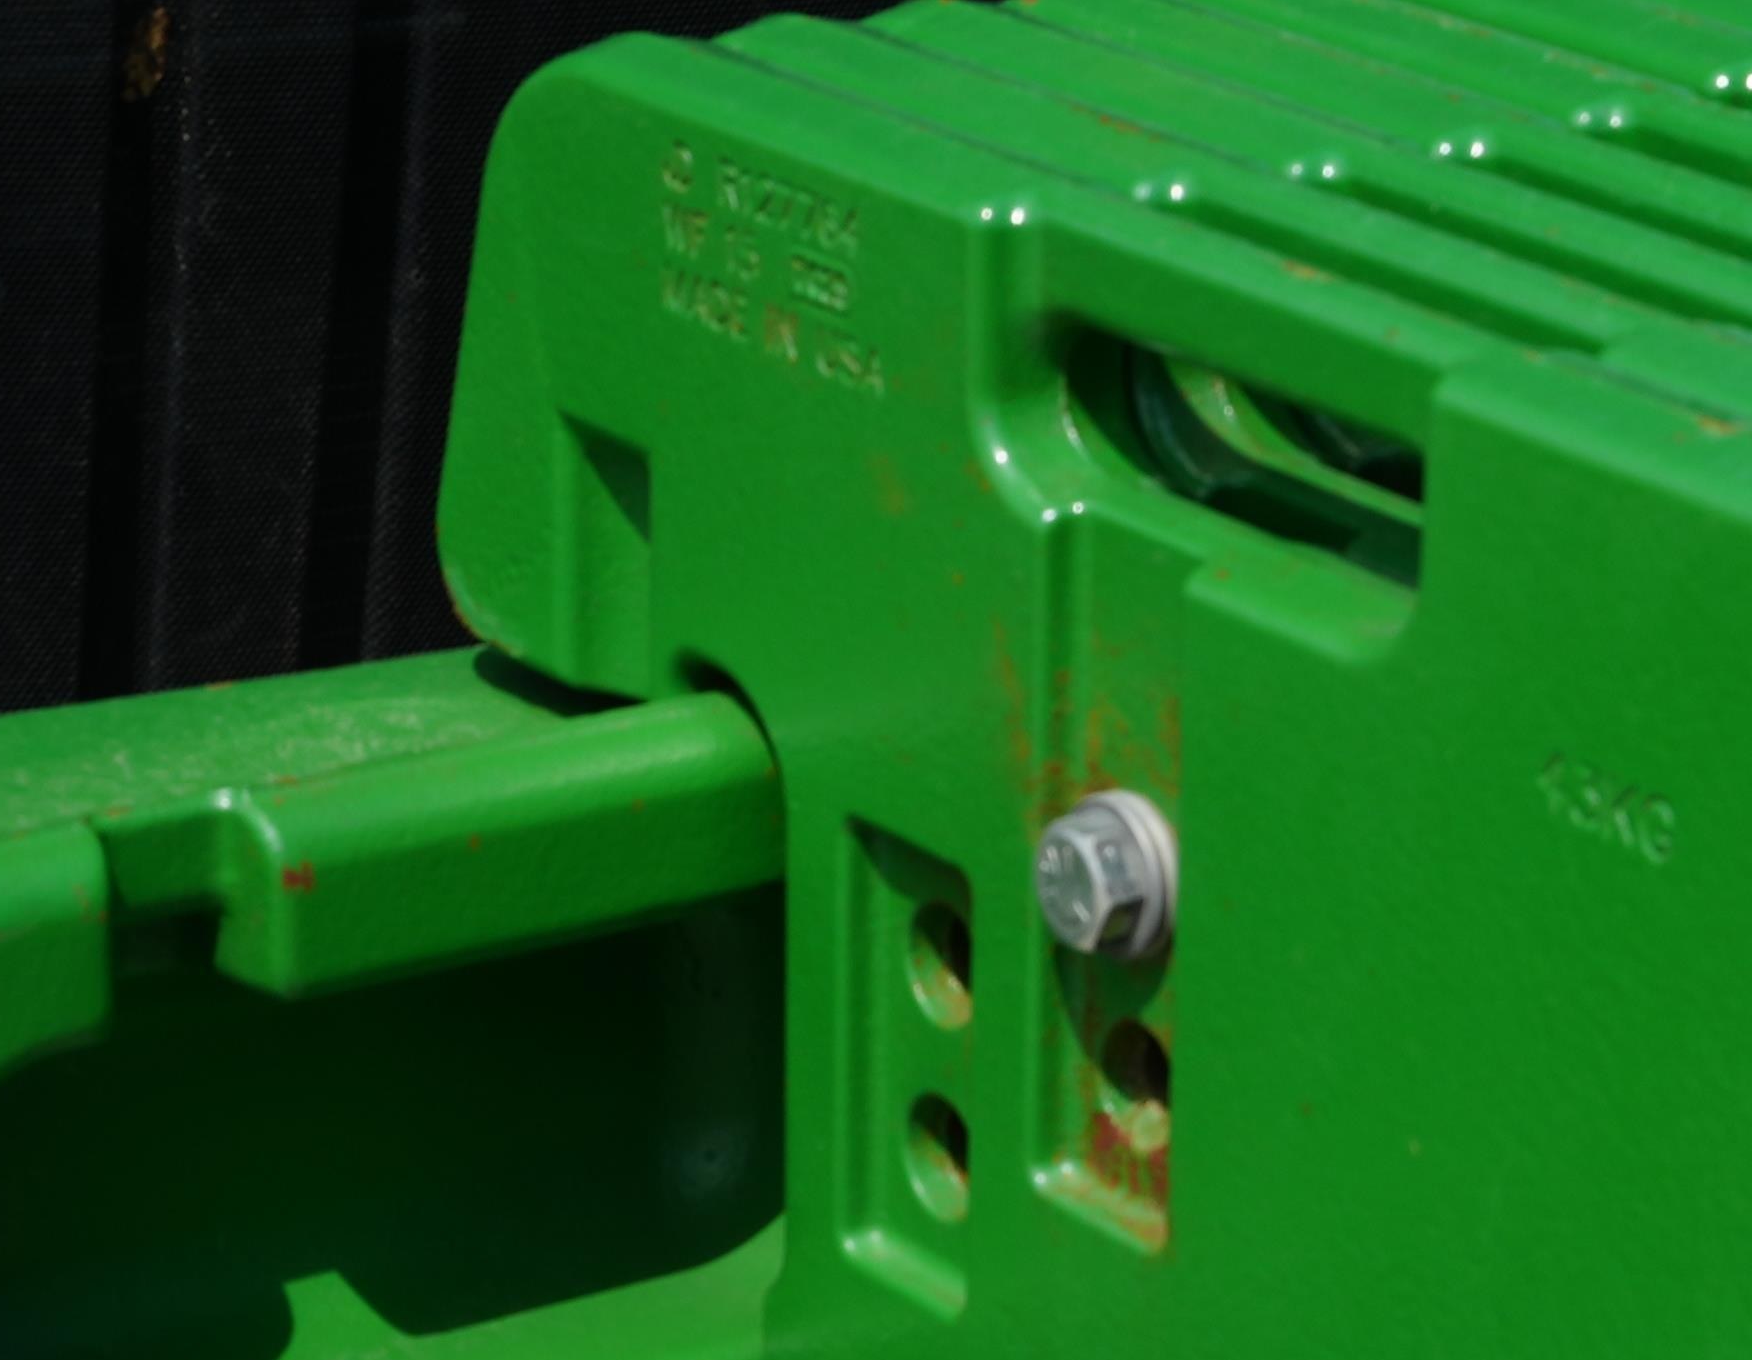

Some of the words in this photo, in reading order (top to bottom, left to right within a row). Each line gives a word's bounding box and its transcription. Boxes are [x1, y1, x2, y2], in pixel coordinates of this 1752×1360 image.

[661, 264, 750, 344] MADE
[762, 302, 800, 363] IN
[815, 331, 886, 398] USA
